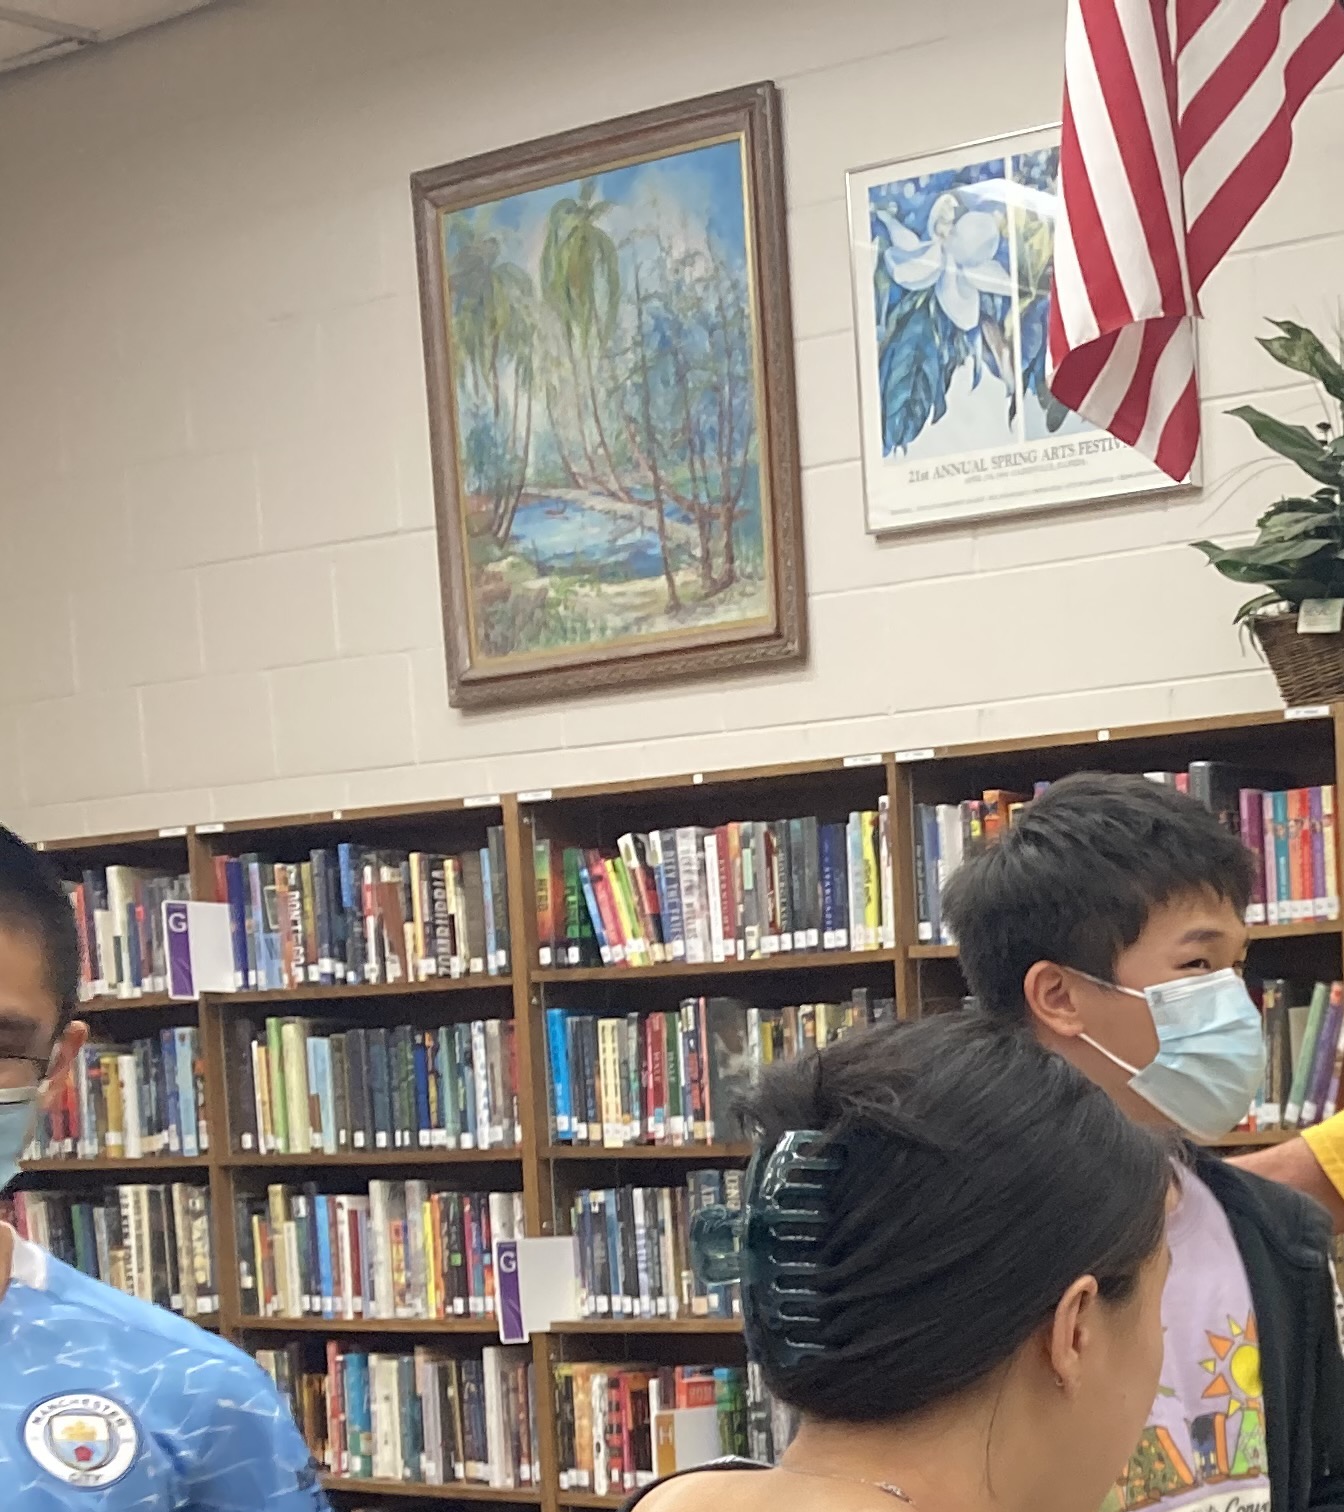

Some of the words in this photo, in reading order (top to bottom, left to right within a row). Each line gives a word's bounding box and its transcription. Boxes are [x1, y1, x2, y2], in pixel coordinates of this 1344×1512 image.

[908, 465, 930, 484] 21st
[933, 457, 988, 479] ANNUAL
[990, 449, 1038, 470] SPRING
[1041, 443, 1076, 462] ARTS
[1078, 437, 1129, 456] FESTIV
[168, 913, 188, 934] G
[499, 1251, 517, 1274] G
